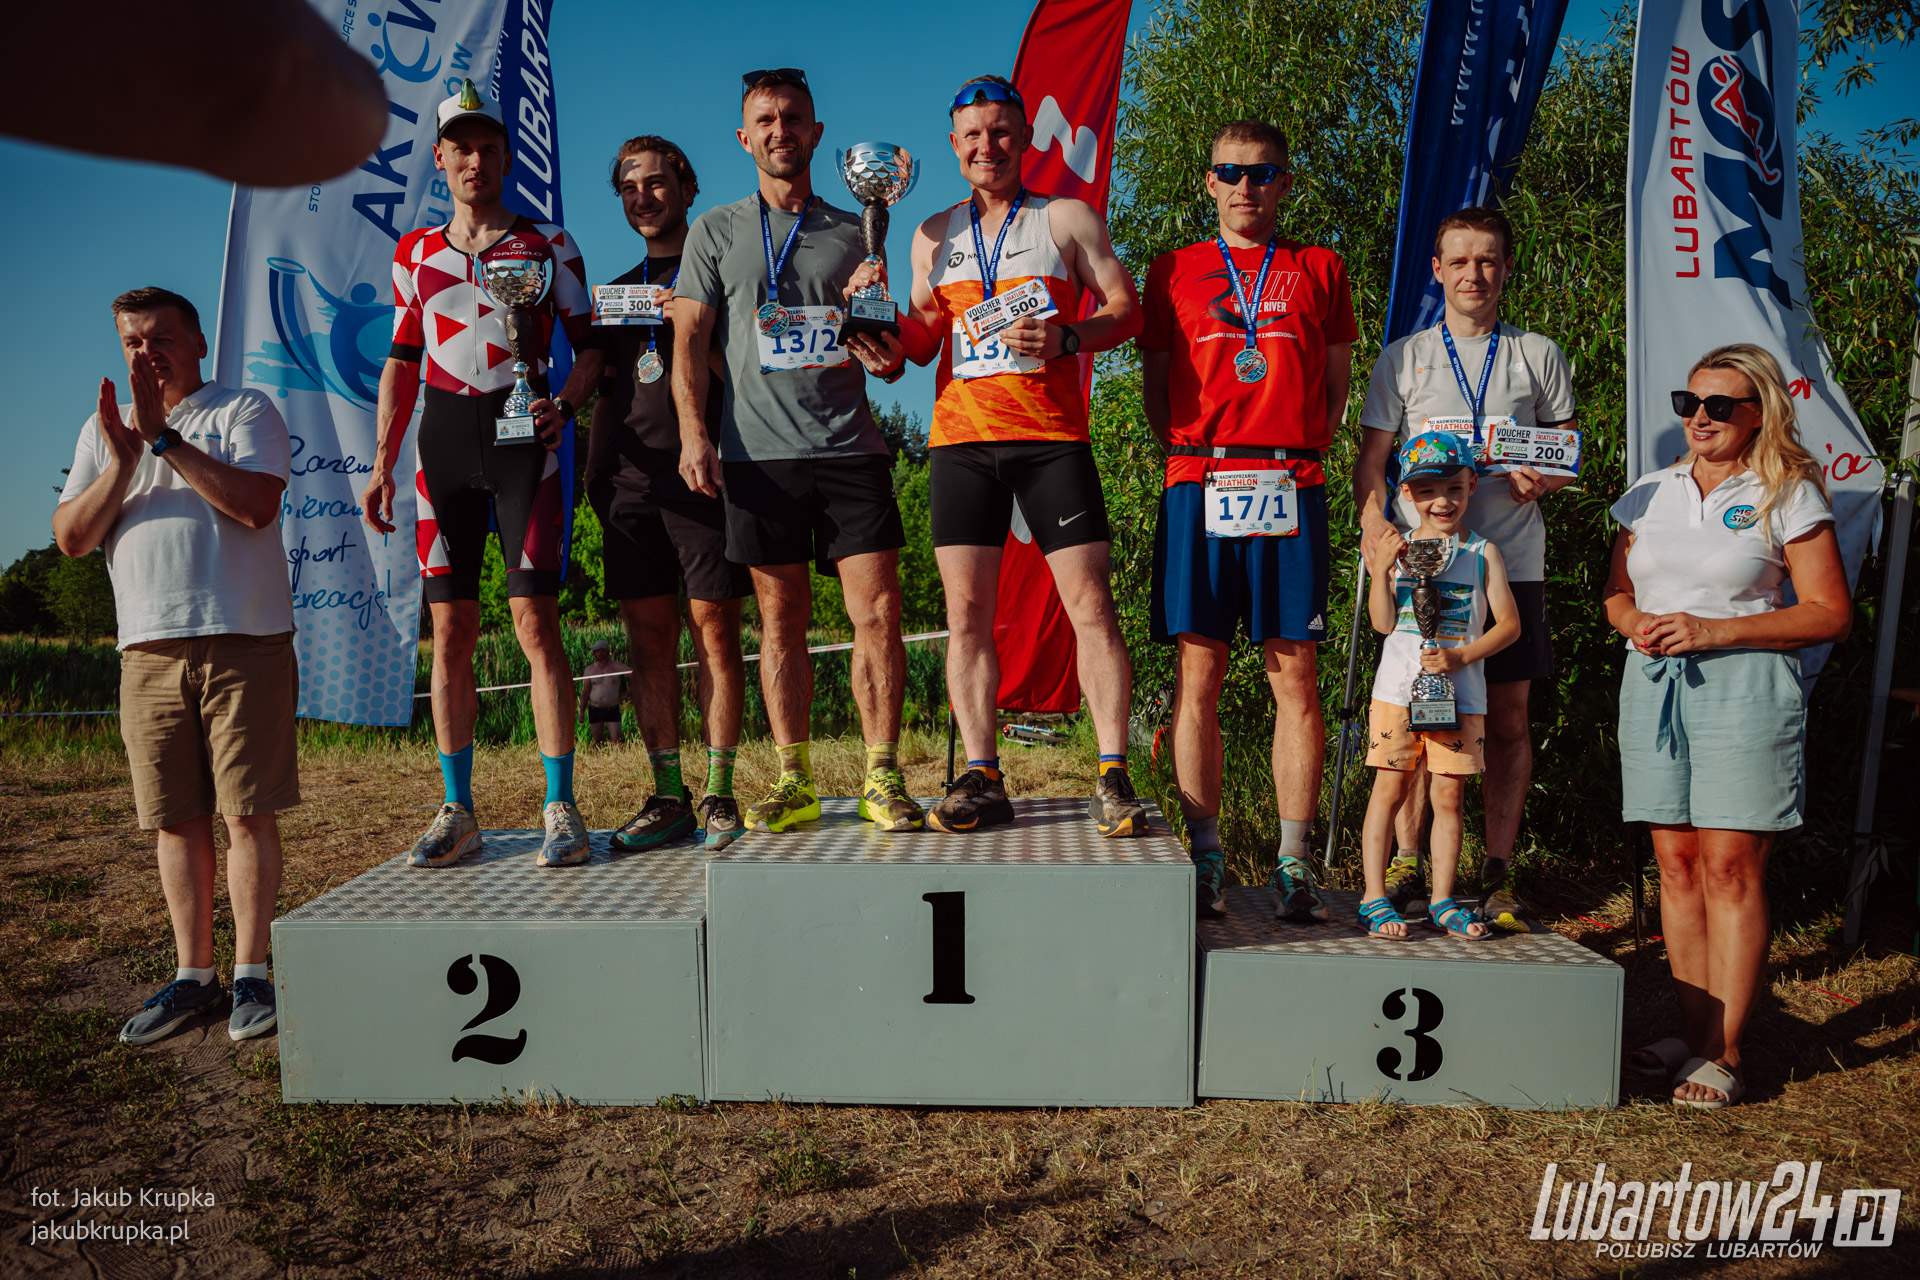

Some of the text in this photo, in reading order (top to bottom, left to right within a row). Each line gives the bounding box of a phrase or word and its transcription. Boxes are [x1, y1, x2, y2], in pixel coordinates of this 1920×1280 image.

[516, 0, 552, 221] LUBART
[1666, 46, 1700, 278] LUBARTÓW
[598, 287, 626, 296] VOUCHER
[628, 300, 652, 312] 300
[966, 298, 1002, 319] VOUCHER
[1010, 296, 1039, 317] 500
[1263, 301, 1288, 313] RIVER
[972, 322, 981, 336] 1
[772, 328, 839, 354] 13/2
[965, 339, 1018, 361] 13/
[1496, 427, 1531, 439] VOUCHER
[1493, 442, 1503, 456] 3
[1535, 446, 1564, 461] 200
[1216, 479, 1258, 487] RIATHLON
[1219, 494, 1288, 520] 17/1
[288, 531, 357, 593] sport
[922, 890, 975, 1004] 1
[446, 953, 527, 1064] 2
[1376, 986, 1444, 1082] 3
